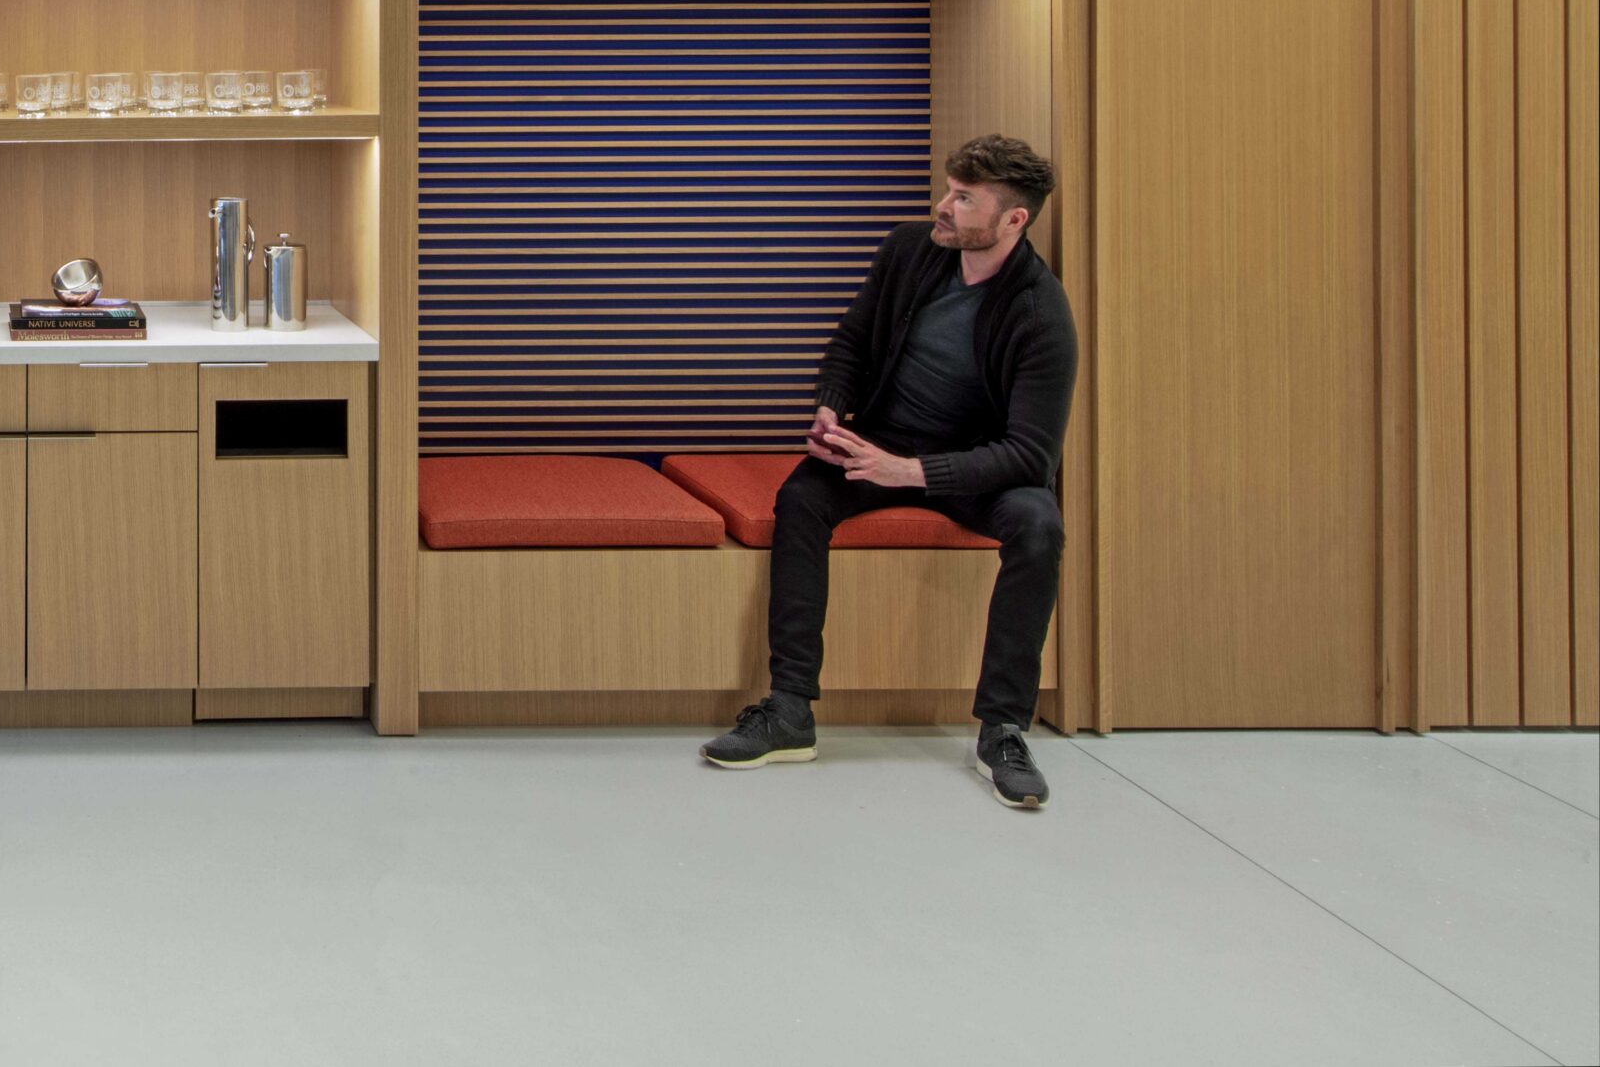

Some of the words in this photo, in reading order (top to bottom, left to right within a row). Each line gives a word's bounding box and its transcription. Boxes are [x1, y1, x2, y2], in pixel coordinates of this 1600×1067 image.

[184, 85, 199, 95] PBS
[255, 84, 269, 94] PBS
[28, 320, 56, 328] NATIVE
[59, 320, 96, 328] UNIVERSE
[17, 330, 70, 340] Molesworth
